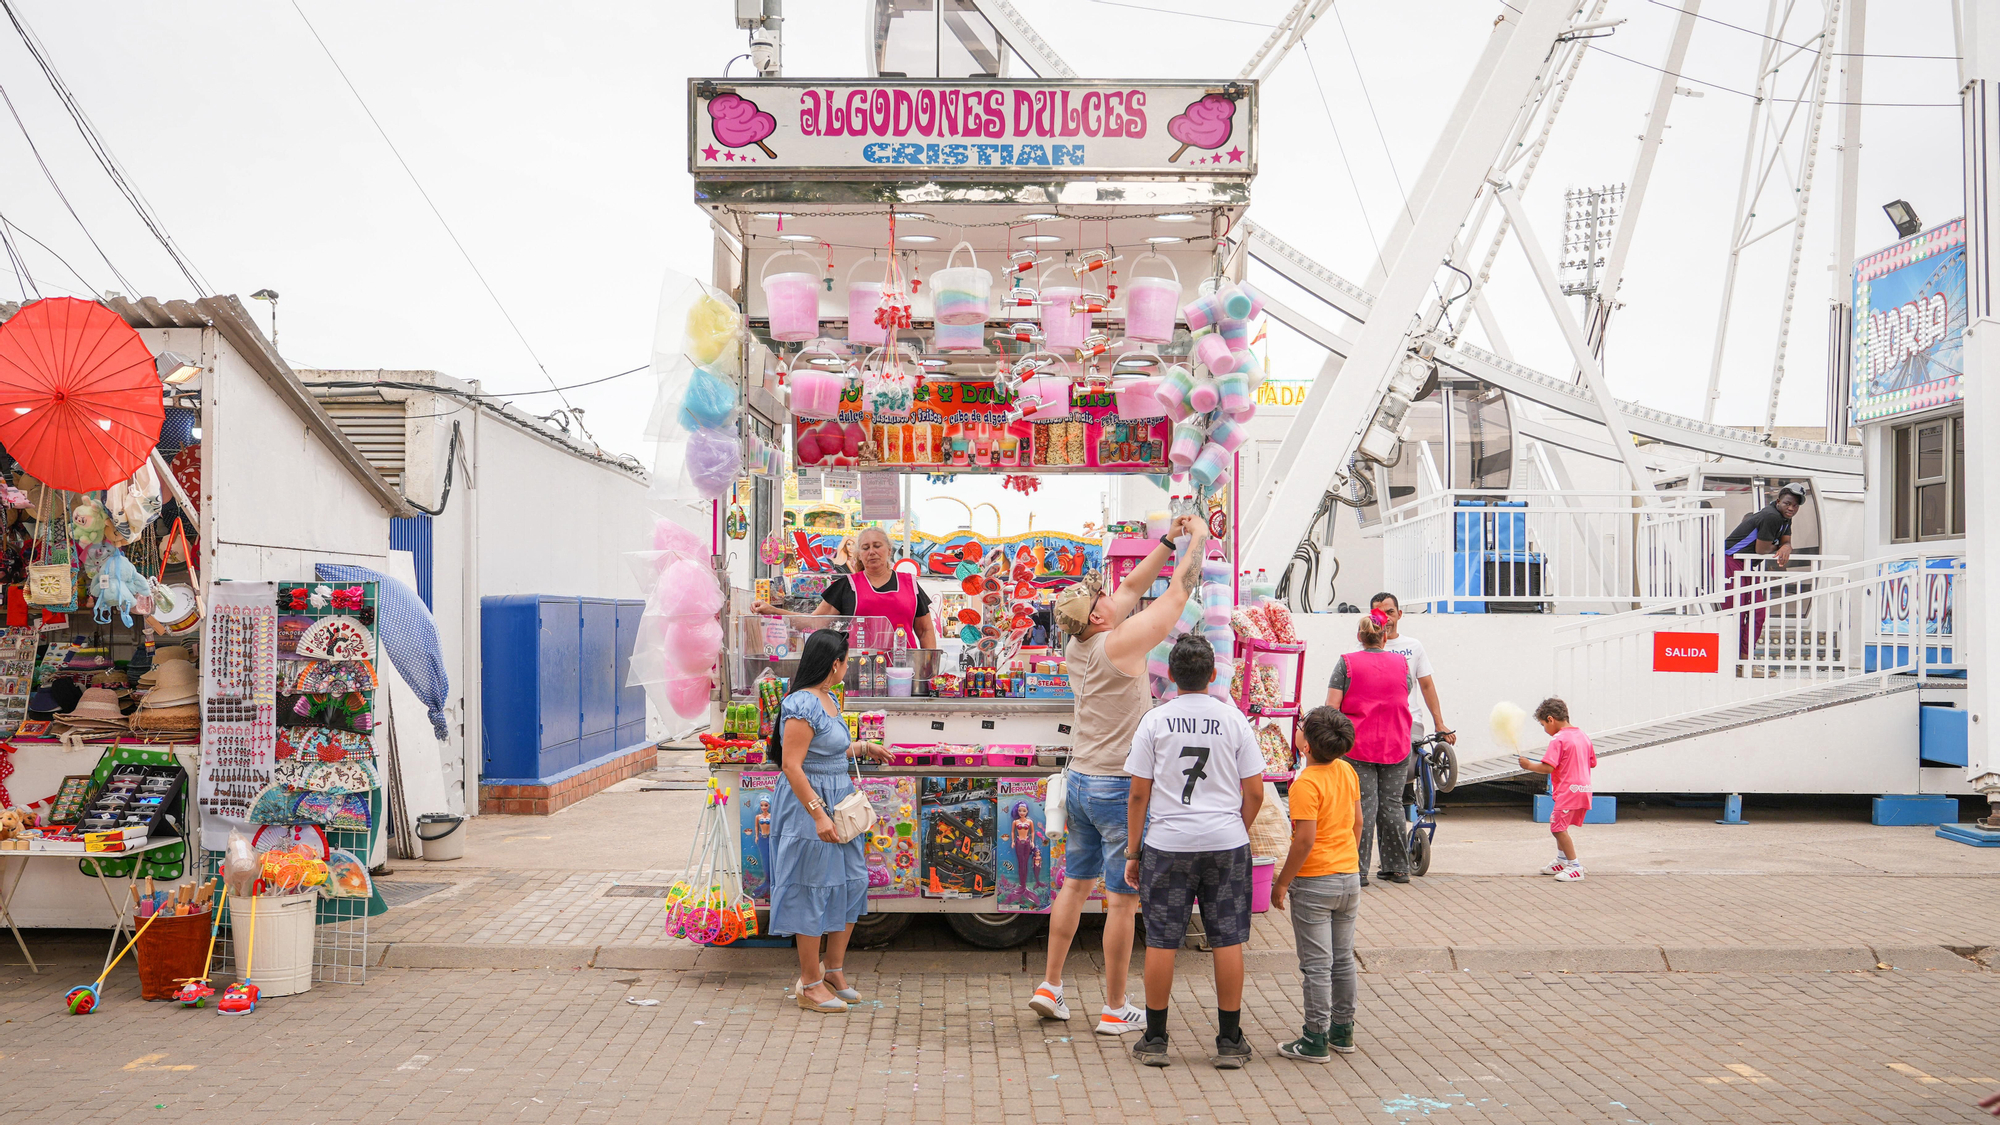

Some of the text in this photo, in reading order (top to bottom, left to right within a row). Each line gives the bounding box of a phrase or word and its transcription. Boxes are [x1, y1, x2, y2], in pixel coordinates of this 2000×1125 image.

[1013, 89, 1147, 139] DULCES
[862, 142, 1085, 166] CRISTIAN
[1868, 291, 1947, 382] NORIA
[838, 409, 864, 424] dulce
[917, 407, 943, 425] fritos
[970, 408, 982, 423] de
[1881, 573, 1949, 621] NOIA
[1665, 647, 1707, 657] SALIDA
[1166, 718, 1223, 736] VINI JR.
[1179, 746, 1210, 805] 7
[1000, 782, 1037, 794] MERMAID
